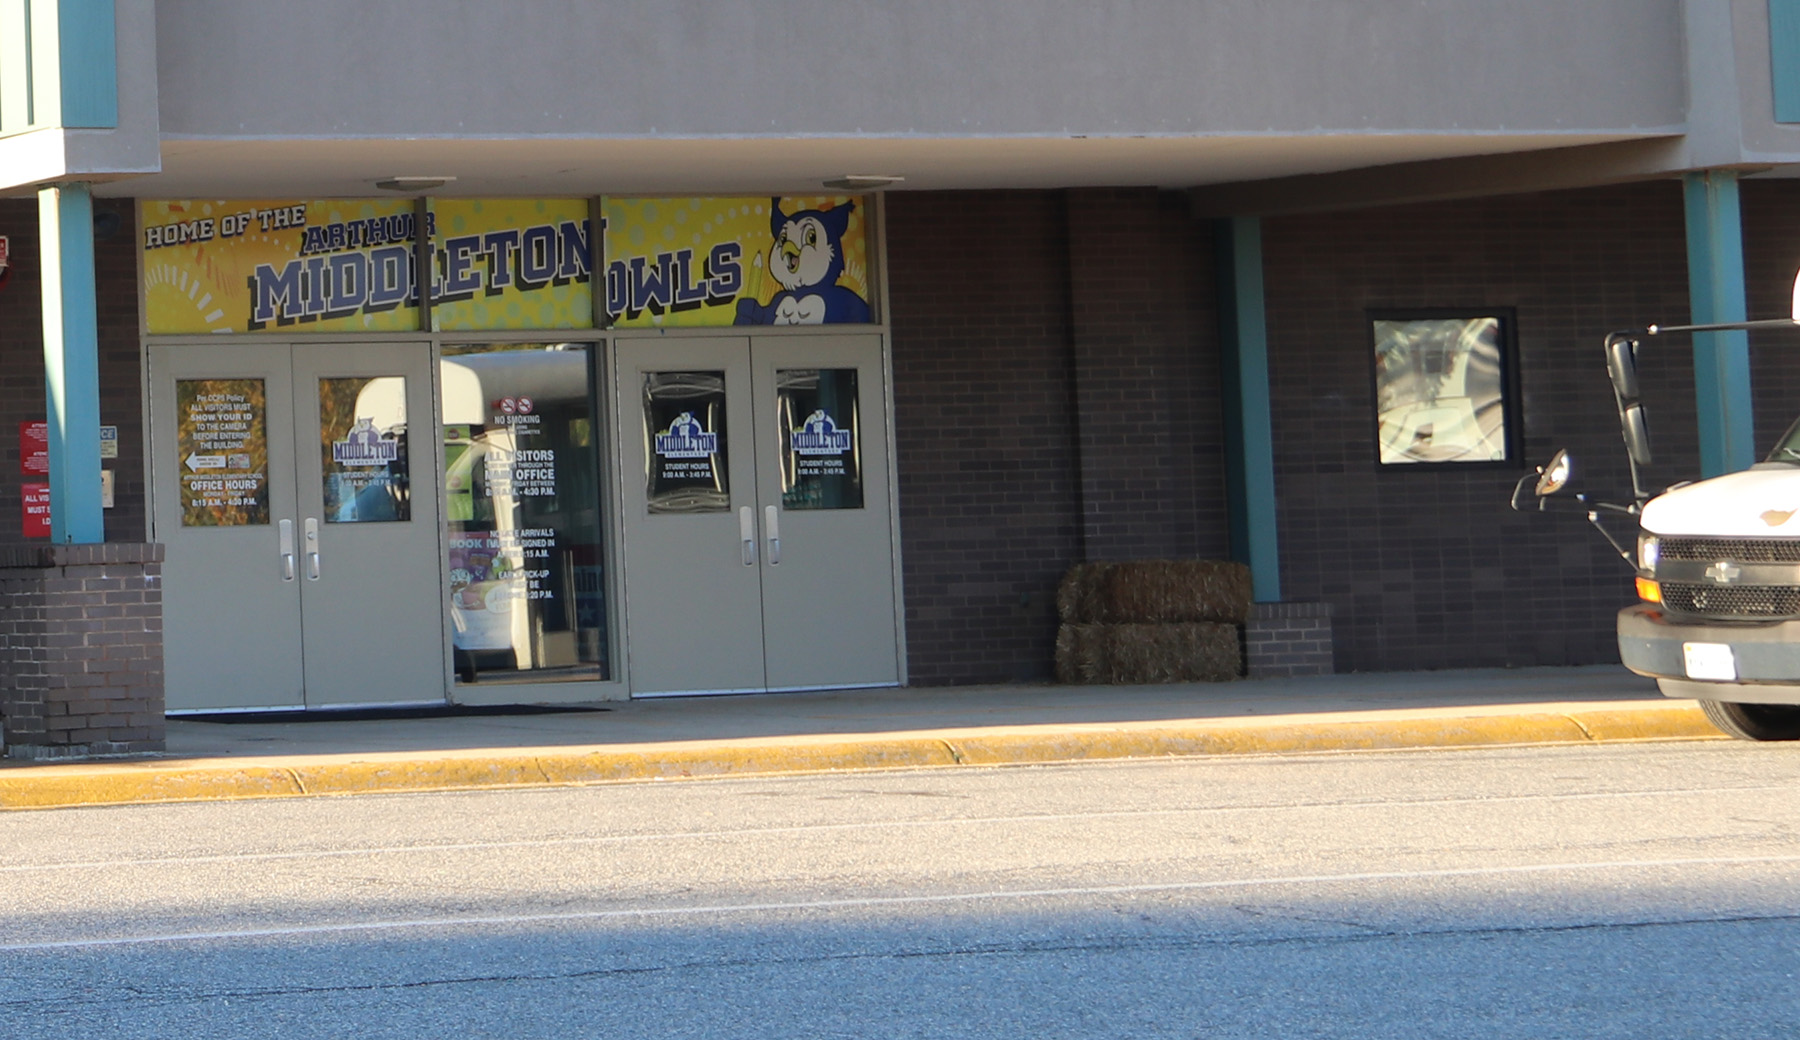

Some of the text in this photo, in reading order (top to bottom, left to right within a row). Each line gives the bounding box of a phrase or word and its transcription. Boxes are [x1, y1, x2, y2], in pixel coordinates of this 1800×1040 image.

[145, 204, 308, 250] HOME OF THE
[302, 211, 435, 255] ARTHUR
[251, 217, 744, 325] MIDDLETON OWLS
[191, 403, 251, 412] ALL VISITORS MUST
[190, 414, 215, 422] SHOW
[218, 413, 241, 421] YOUR
[495, 415, 540, 424] NO SMOKING
[196, 423, 205, 431] TO
[206, 423, 219, 431] THE
[192, 432, 251, 440] BEFORE ENTERING
[792, 432, 848, 449] MIDDLETON
[656, 435, 715, 452] MIDDLETON
[334, 442, 395, 460] MIDDLETON
[516, 469, 555, 480] OFFICE
[191, 480, 257, 490] OFFICE HOURS
[27, 506, 45, 514] MUST
[521, 528, 554, 537] ARRIVALS
[521, 539, 546, 547] SIGNED
[547, 538, 555, 547] IN
[529, 580, 540, 588] BE
